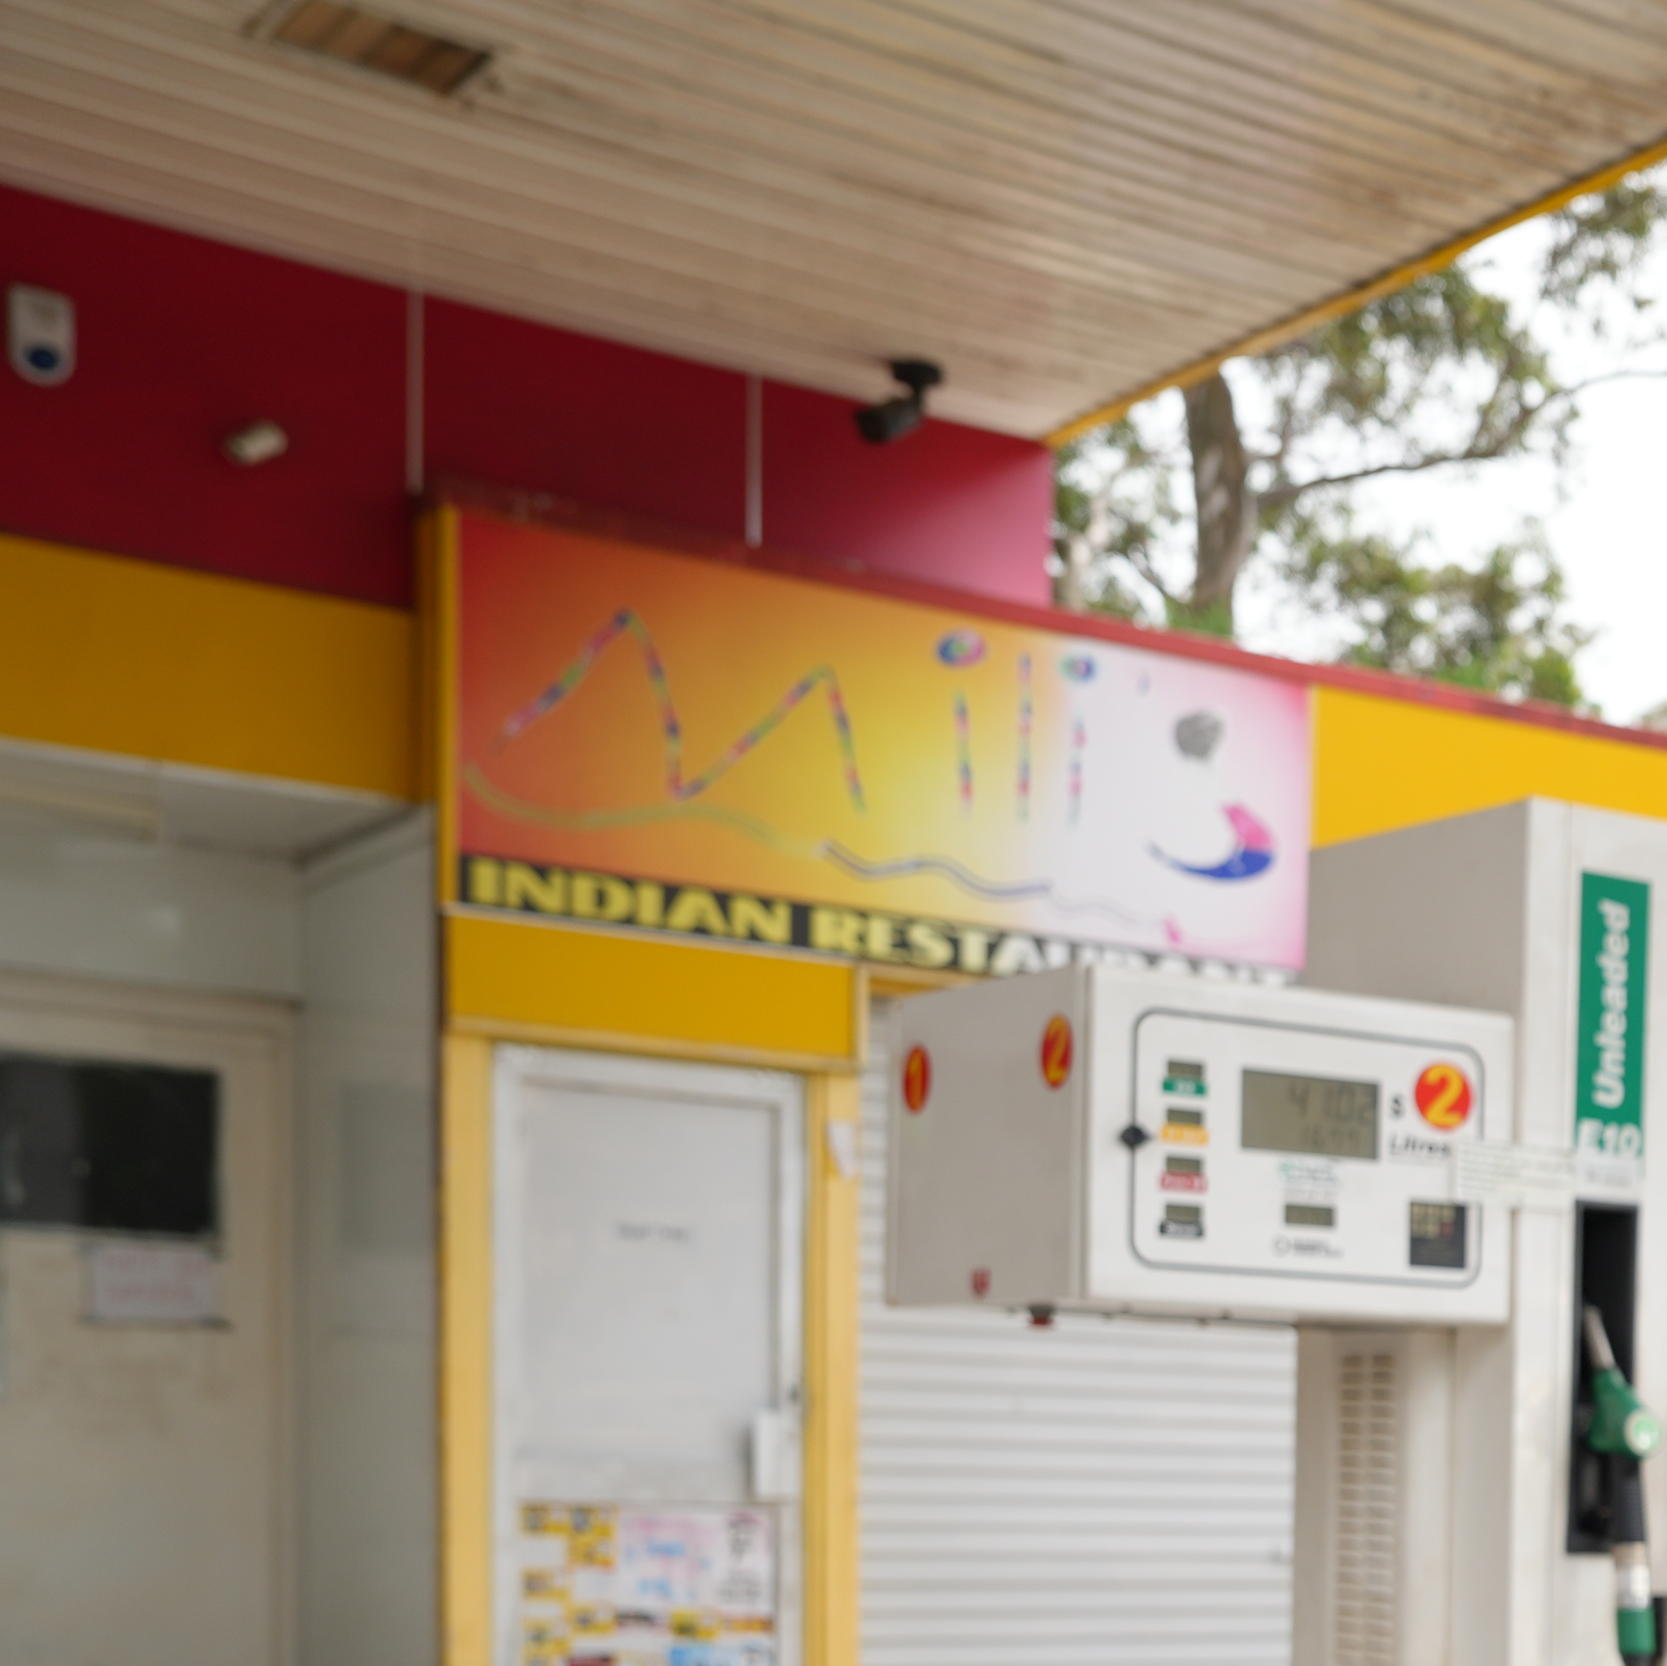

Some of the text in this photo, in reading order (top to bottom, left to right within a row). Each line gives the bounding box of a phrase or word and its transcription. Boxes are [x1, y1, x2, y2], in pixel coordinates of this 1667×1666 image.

[470, 857, 792, 945] INDIAN
[1592, 898, 1630, 1109] Unleaded
[1046, 1017, 1070, 1086] 2
[1420, 1064, 1467, 1127] 2
